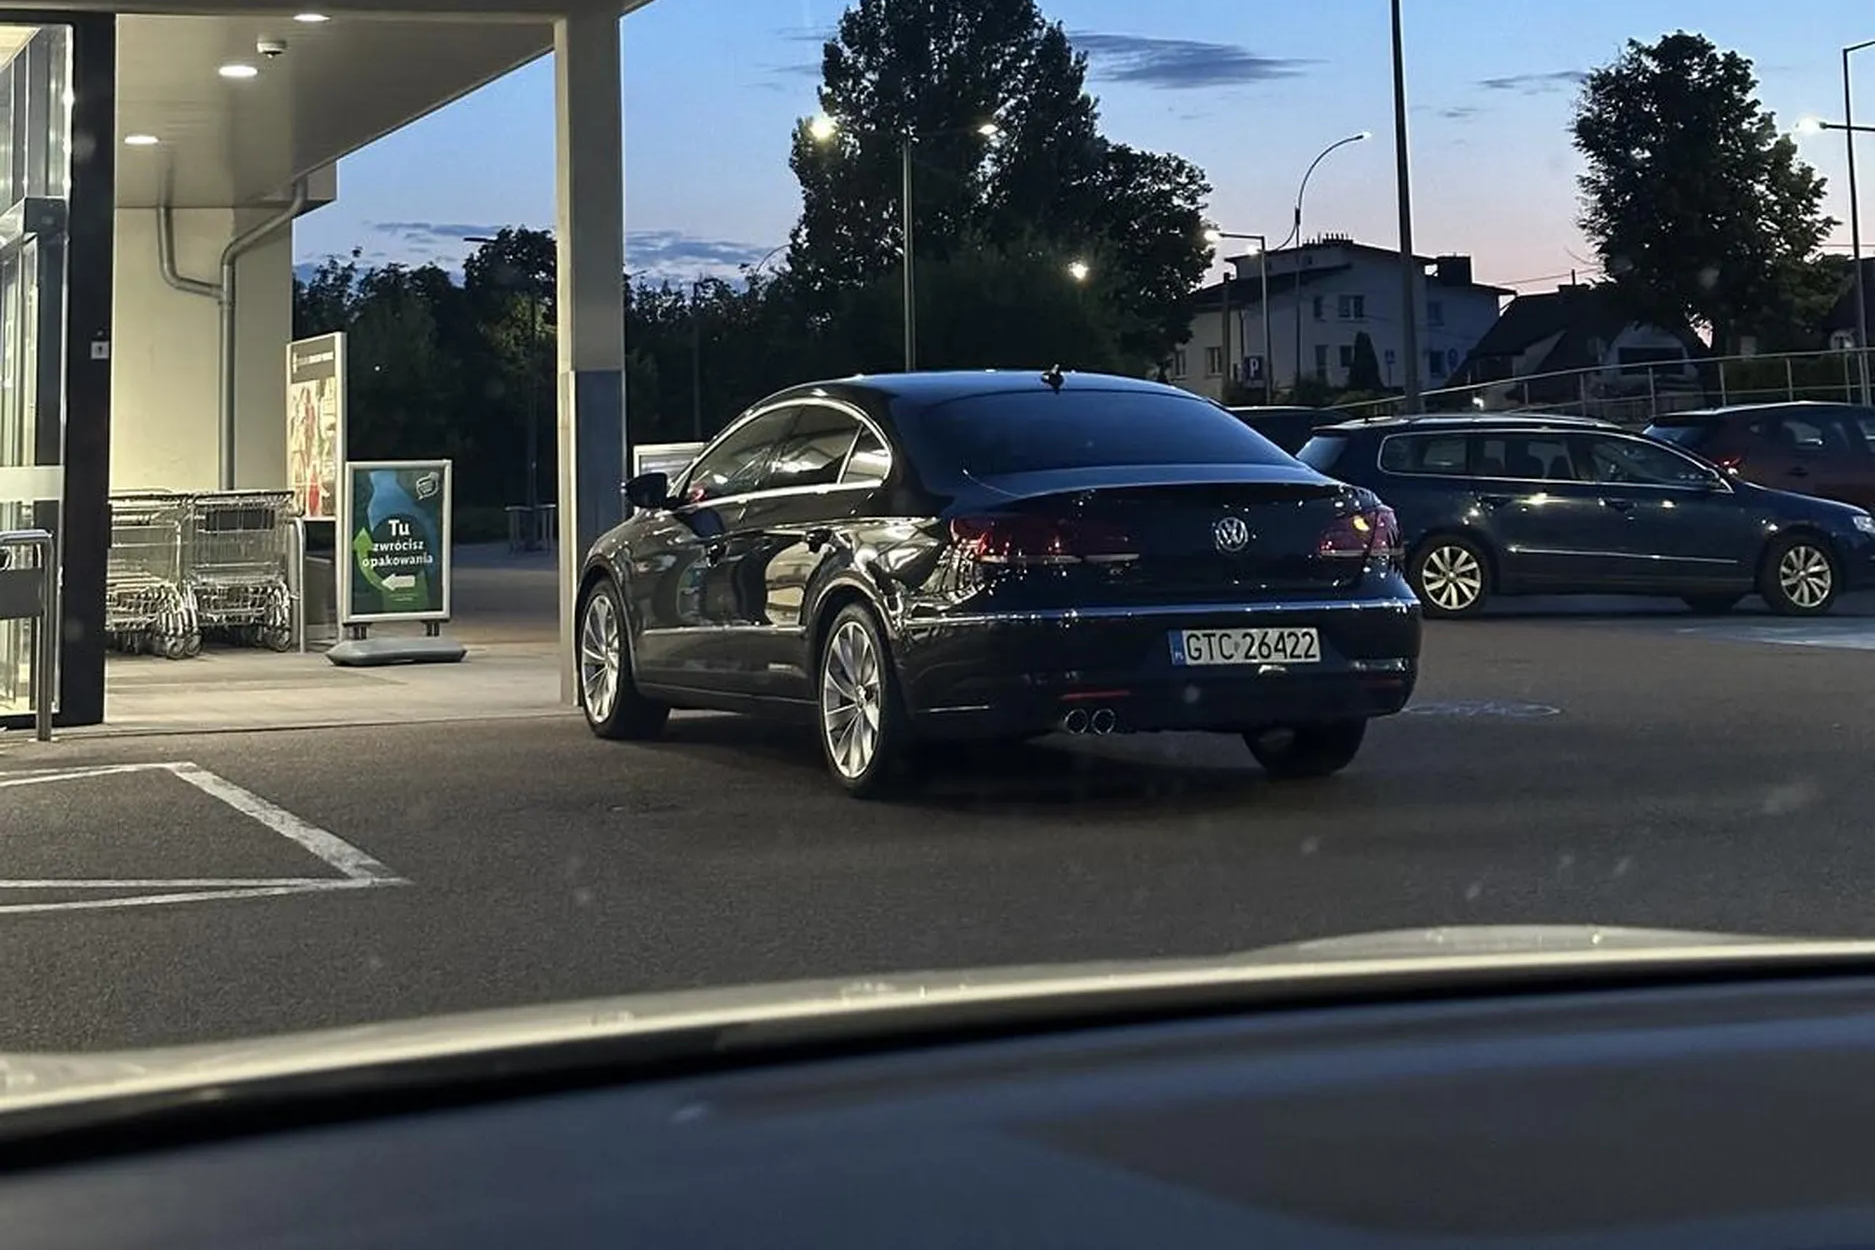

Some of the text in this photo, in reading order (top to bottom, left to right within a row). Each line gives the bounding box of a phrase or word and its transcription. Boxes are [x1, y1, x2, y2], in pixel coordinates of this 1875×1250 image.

[1249, 357, 1259, 378] P
[388, 519, 410, 536] Tu
[372, 538, 424, 552] zwrócisz
[362, 553, 434, 570] opakowania
[1186, 631, 1317, 661] GTC 26422
